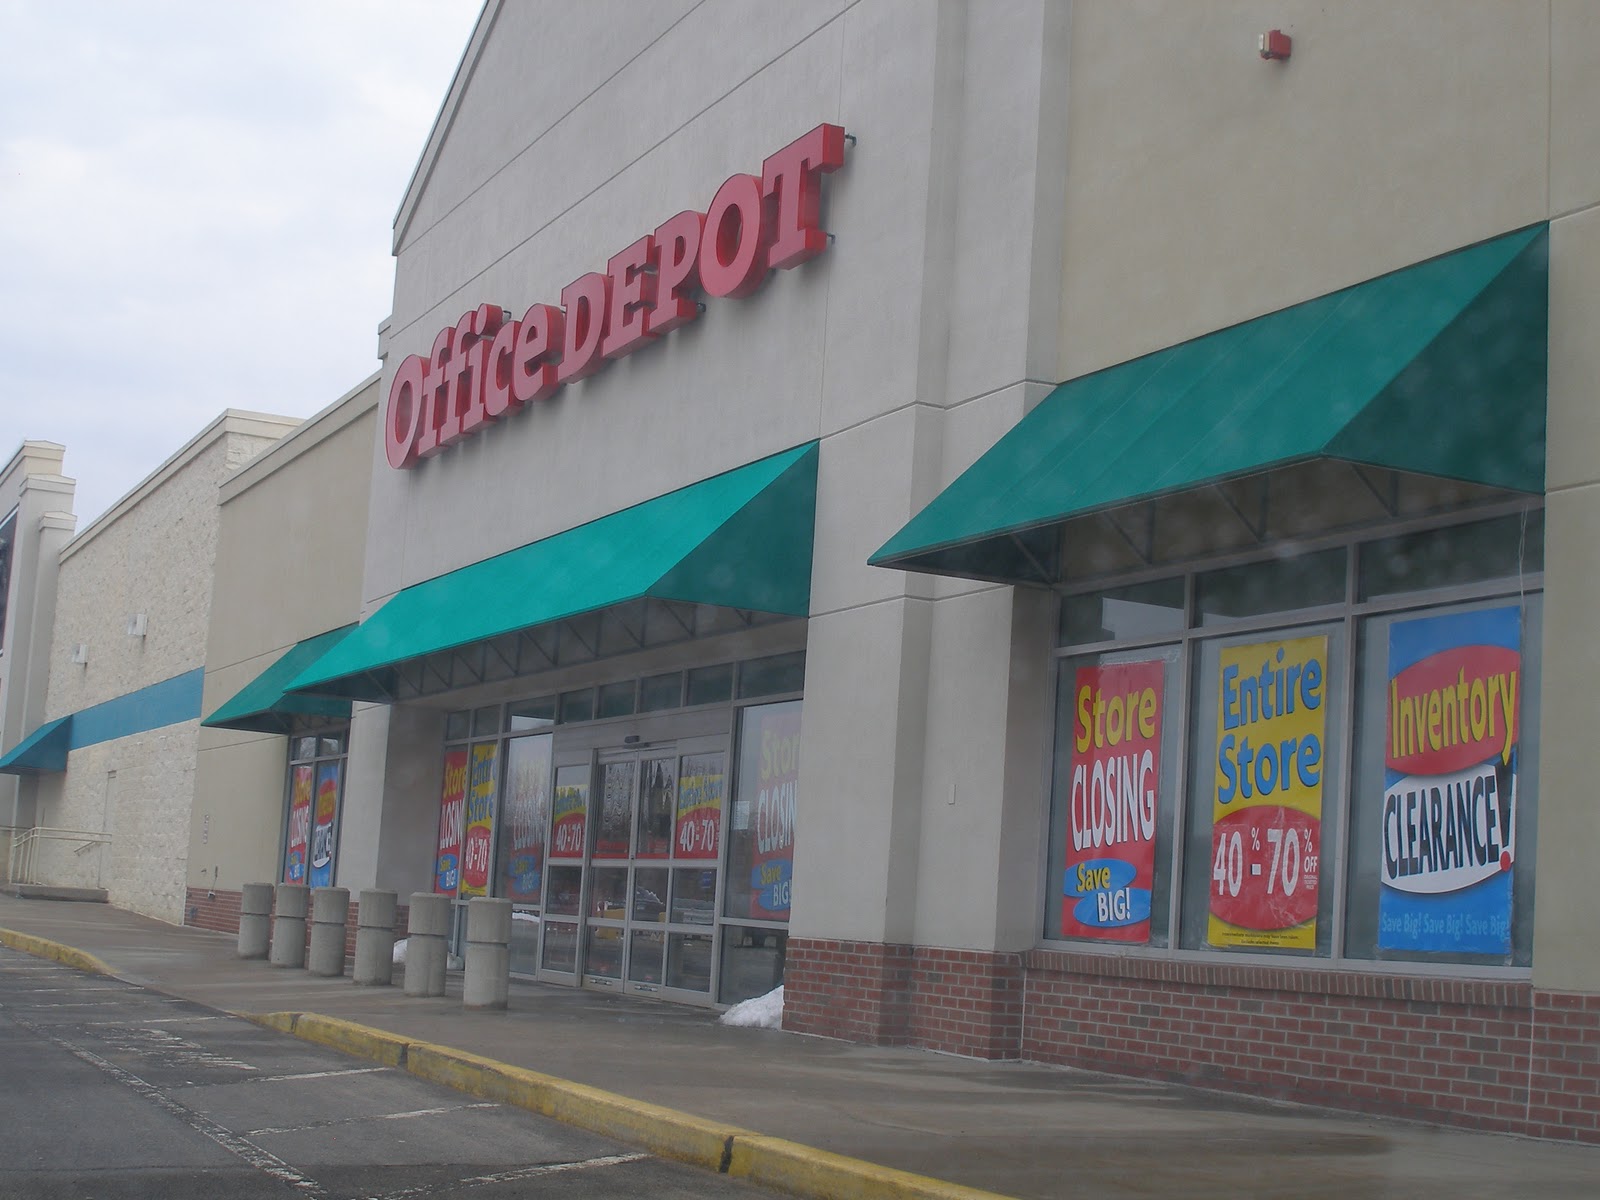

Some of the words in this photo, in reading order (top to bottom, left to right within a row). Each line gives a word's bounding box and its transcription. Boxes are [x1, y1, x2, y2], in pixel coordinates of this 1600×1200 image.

[385, 303, 566, 470] Office
[558, 123, 845, 385] DEPOT
[1077, 685, 1156, 753] Store
[1223, 647, 1322, 730] Entire
[1391, 666, 1516, 766] Inventory
[760, 730, 799, 780] Stor
[1218, 733, 1321, 804] Store
[757, 779, 798, 855] CLOSIN
[1071, 749, 1154, 851] CLOSING
[760, 863, 781, 886] Save
[1076, 863, 1111, 892] Save
[1303, 855, 1318, 873] OFF
[1097, 887, 1131, 922] BIG!
[1382, 912, 1401, 932] Save
[1404, 913, 1422, 939] Big!
[1423, 913, 1444, 934] Save
[1447, 914, 1464, 940] Big!
[1465, 914, 1488, 935] Save
[1490, 915, 1510, 942] Big!
